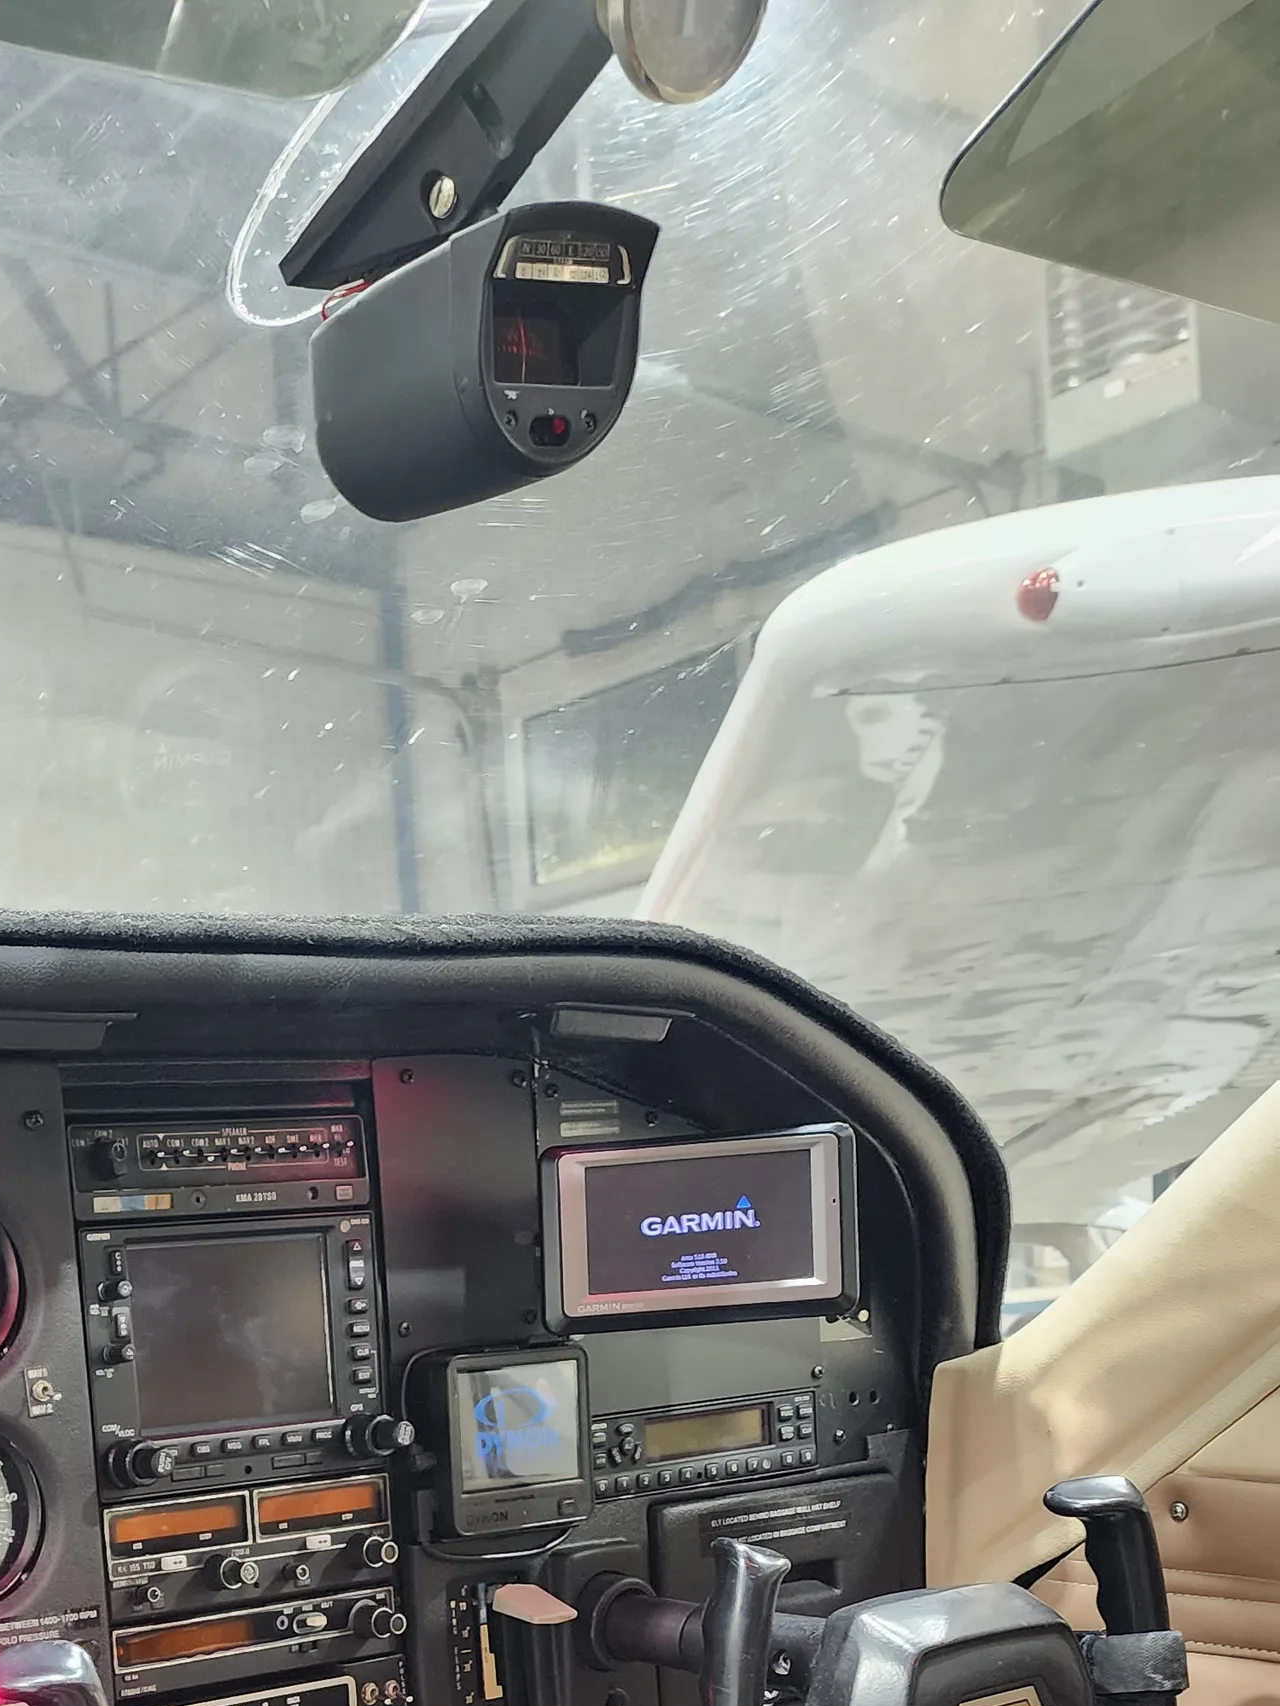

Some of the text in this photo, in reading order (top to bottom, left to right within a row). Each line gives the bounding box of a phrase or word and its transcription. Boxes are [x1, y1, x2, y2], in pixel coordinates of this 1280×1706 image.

[577, 1302, 621, 1313] GARMIN
[475, 1427, 560, 1460] DYNON
[0, 1619, 40, 1635] BETWEEN
[19, 1628, 60, 1645] PRESSURE
